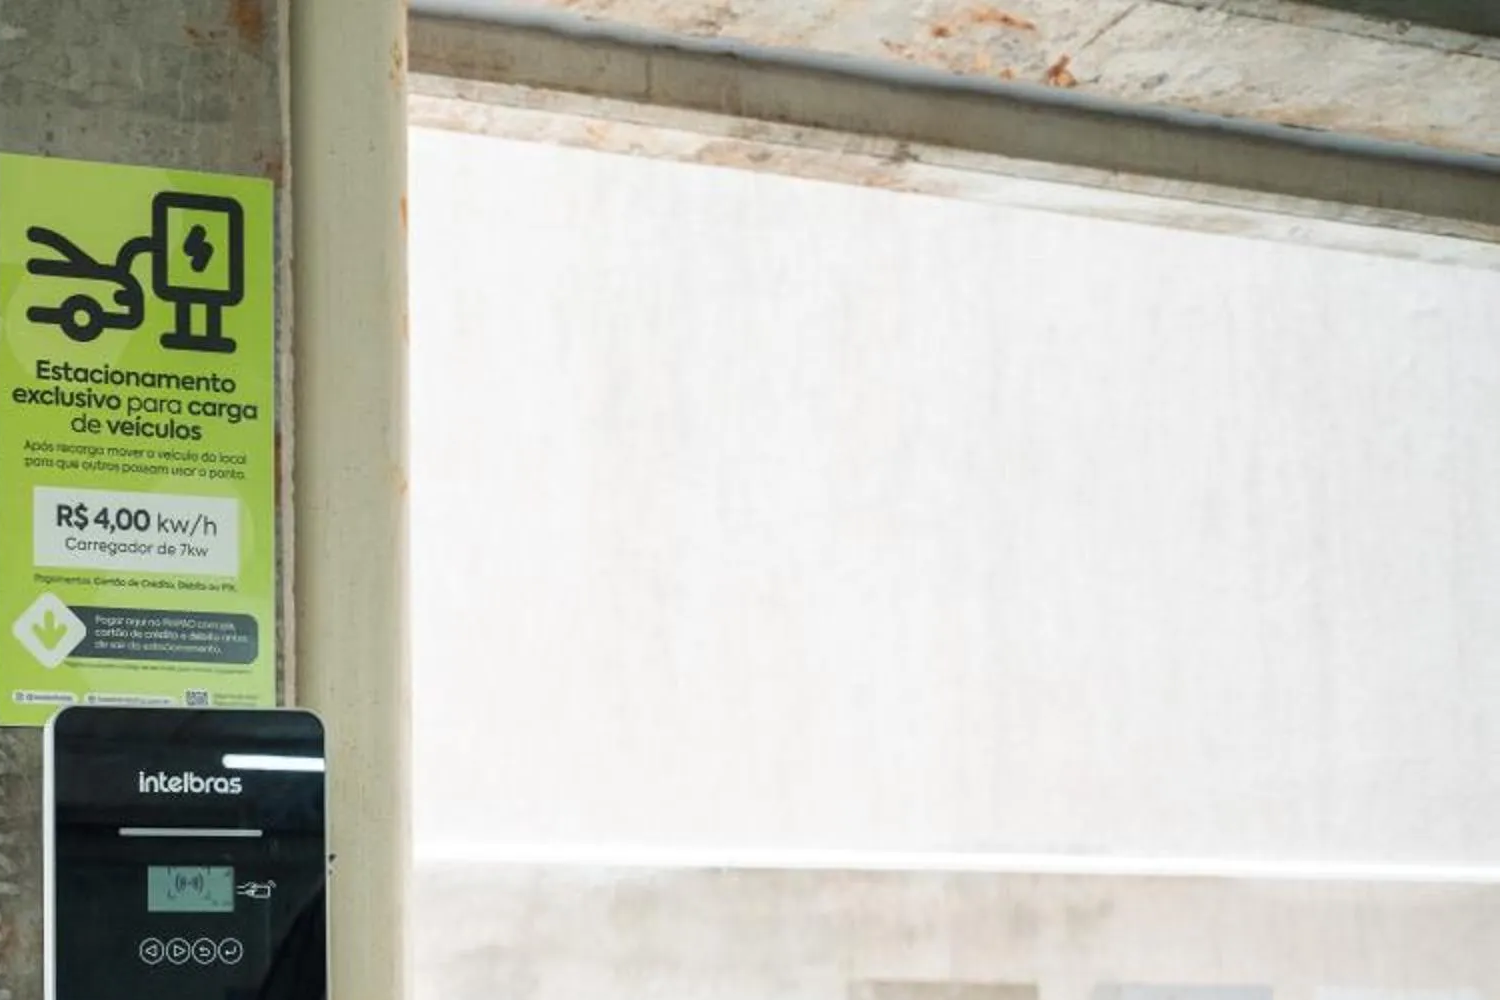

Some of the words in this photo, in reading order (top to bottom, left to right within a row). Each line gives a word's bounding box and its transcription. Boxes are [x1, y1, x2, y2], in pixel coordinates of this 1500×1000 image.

[36, 359, 236, 394] Estacionamento
[12, 386, 121, 410] exclusivo
[127, 395, 182, 416] para
[187, 400, 258, 424] carga
[71, 413, 101, 434] de
[106, 415, 203, 441] veículos
[56, 444, 104, 457] recarga
[107, 447, 144, 458] mover
[146, 450, 155, 458] o
[201, 452, 217, 463] do
[219, 452, 246, 464] local
[55, 459, 79, 470] que
[171, 467, 196, 477] usar
[198, 469, 206, 477] o
[56, 503, 89, 530] R$
[94, 507, 151, 534] 4,00
[157, 512, 218, 536] kw/h
[65, 537, 152, 555] Carregador
[157, 542, 177, 556] de
[179, 543, 209, 557] 7kw
[138, 771, 243, 795] intelbras
